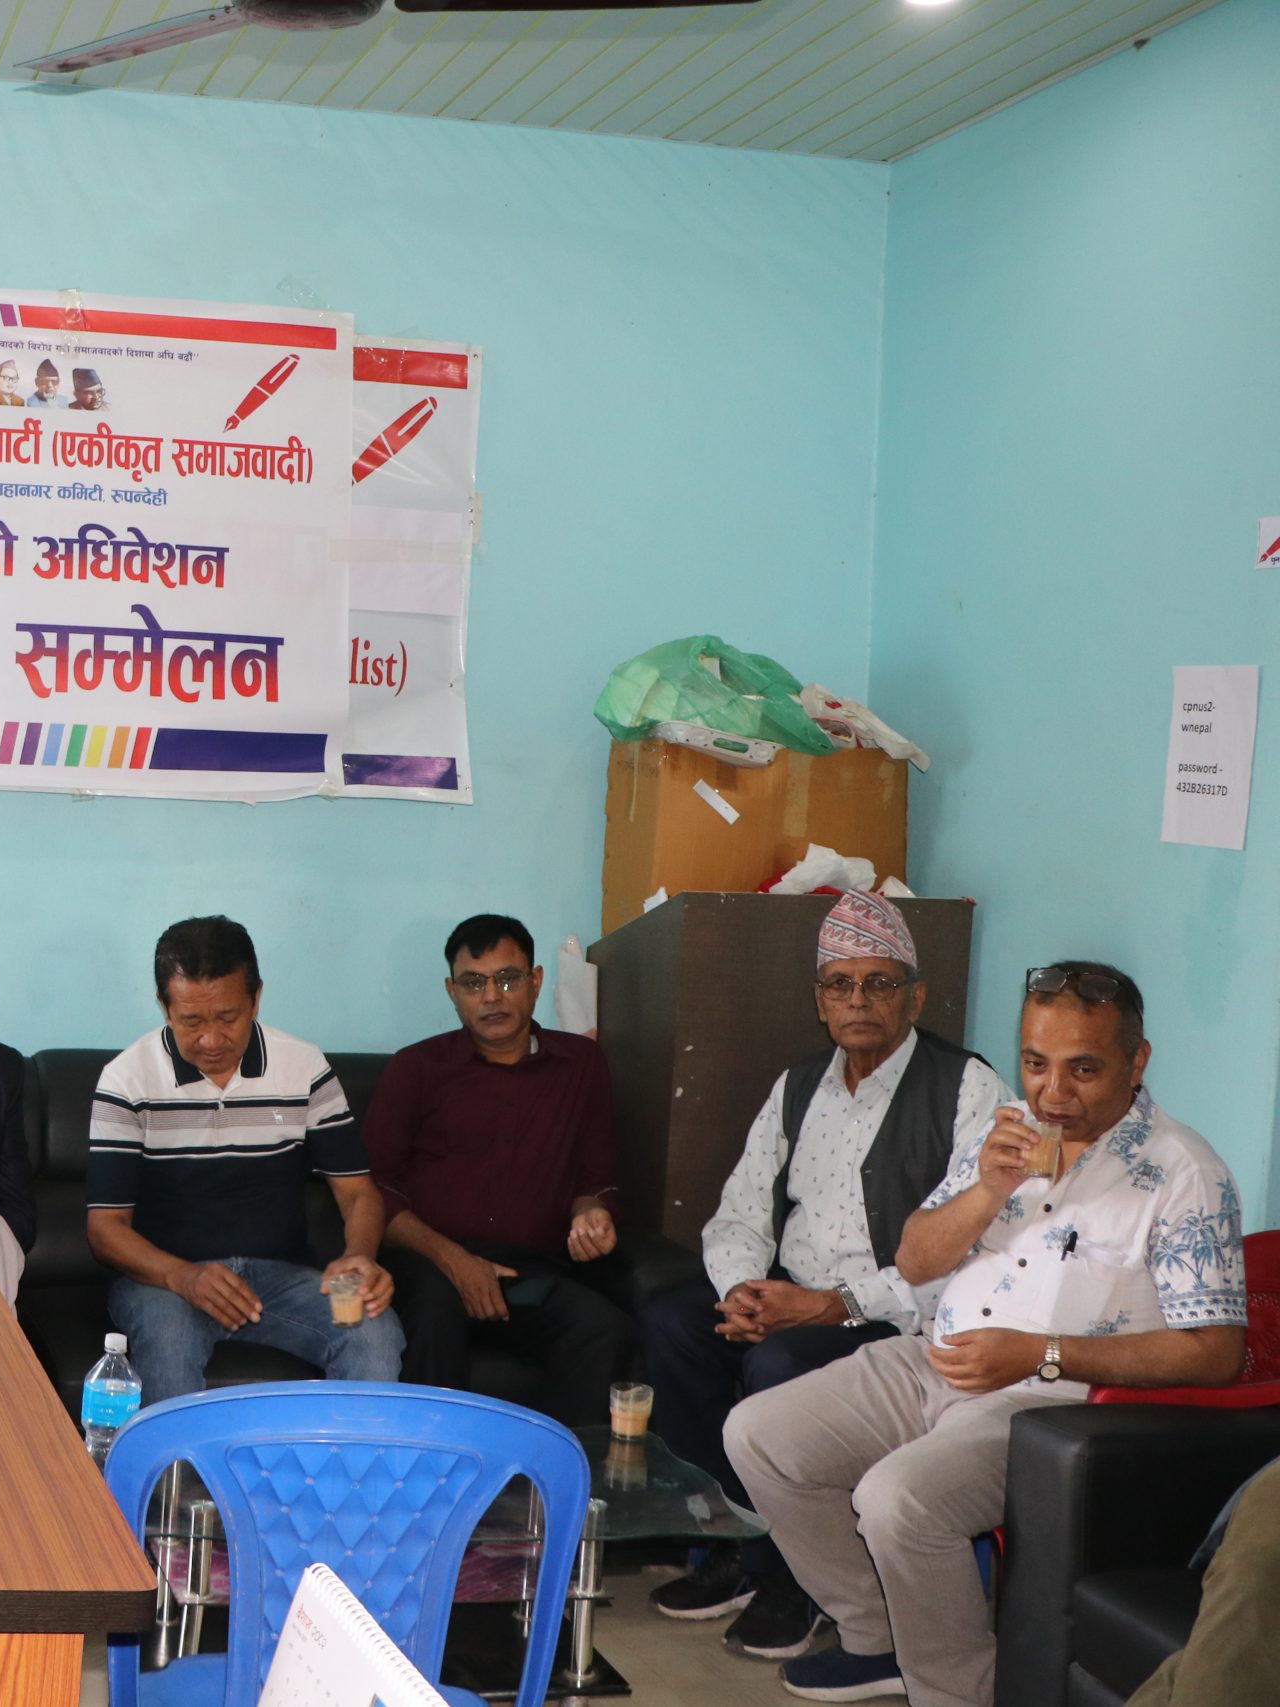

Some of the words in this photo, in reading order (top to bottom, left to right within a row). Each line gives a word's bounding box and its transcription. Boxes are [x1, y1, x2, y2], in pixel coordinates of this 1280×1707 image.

[52, 422, 164, 483] (एकीकृत
[172, 436, 314, 485] समाजवादी)
[32, 523, 229, 589] अधिवेशन
[15, 604, 284, 704] सम्मेलन
[1181, 722, 1212, 734] wnepal
[1177, 763, 1218, 774] password
